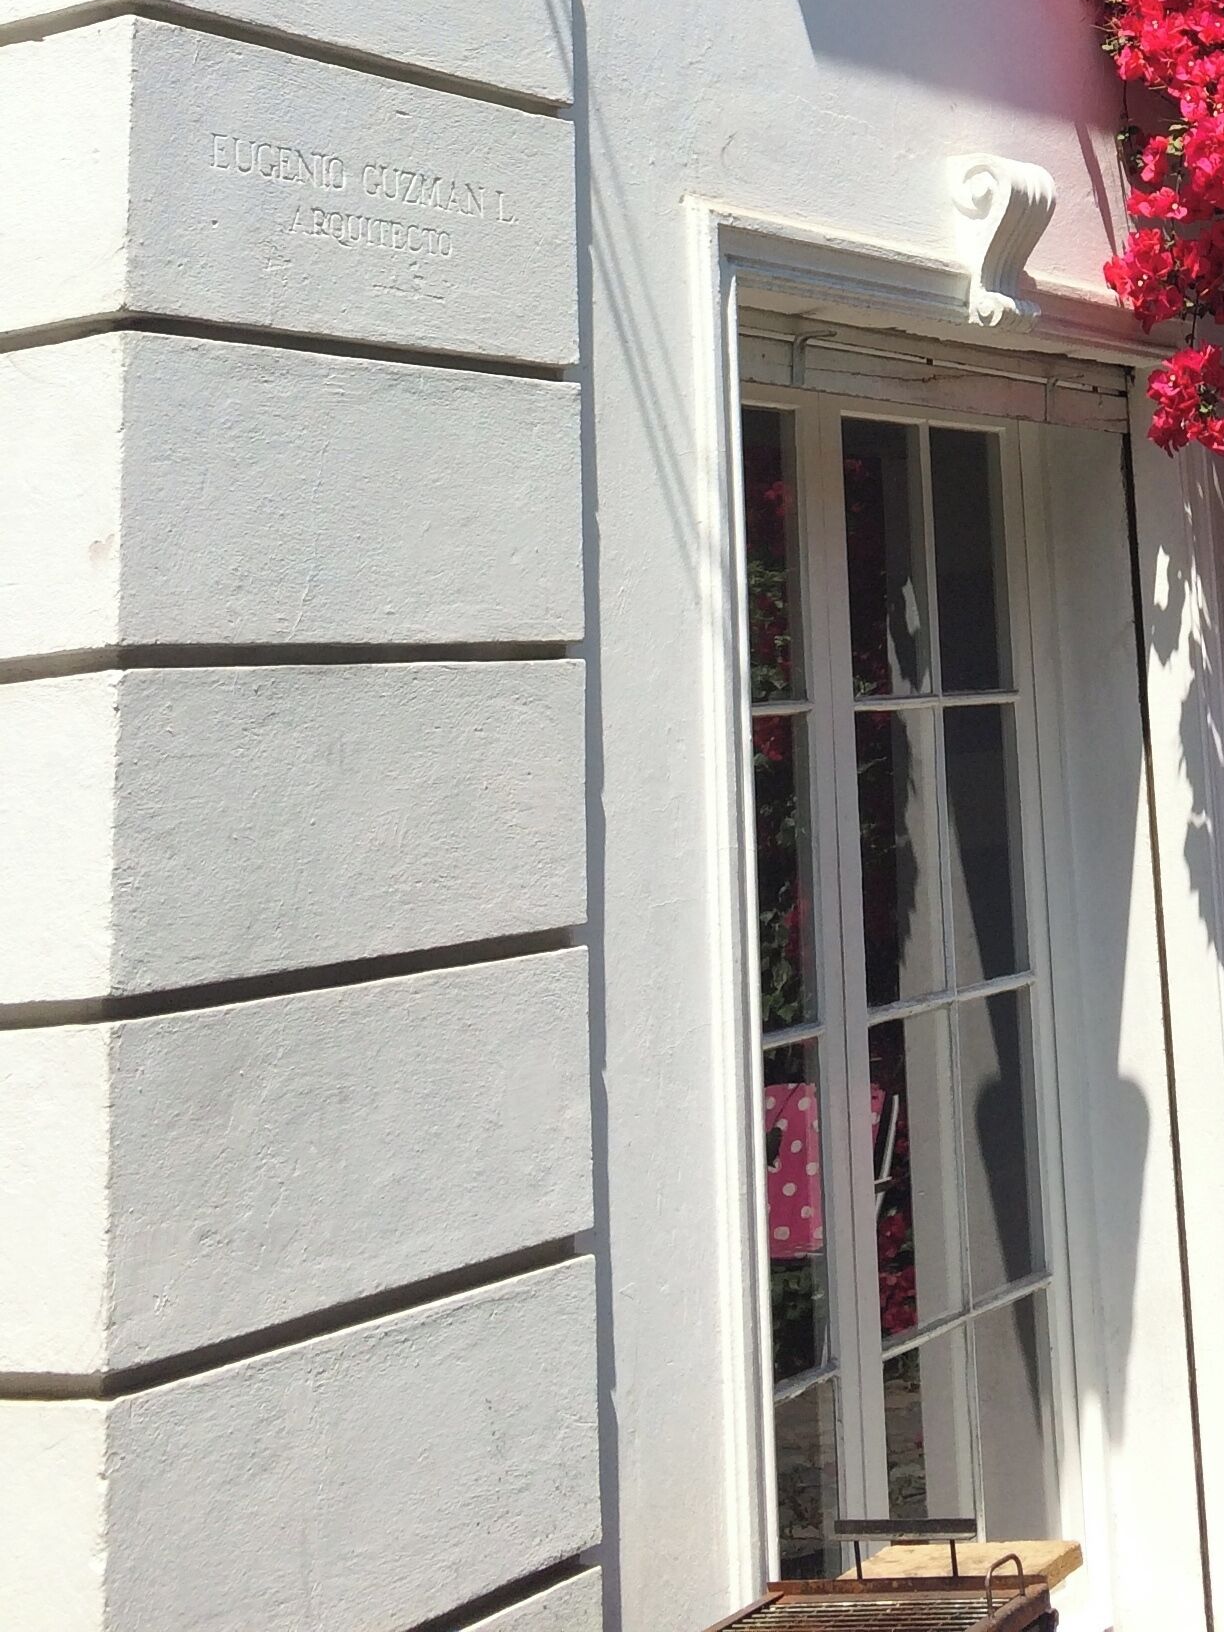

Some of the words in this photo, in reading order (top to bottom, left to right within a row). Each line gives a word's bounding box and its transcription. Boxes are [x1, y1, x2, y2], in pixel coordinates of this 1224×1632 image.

[209, 132, 345, 189] EUGENIO
[362, 165, 486, 218] GUZMAN
[288, 205, 452, 256] ARQUITECTO
